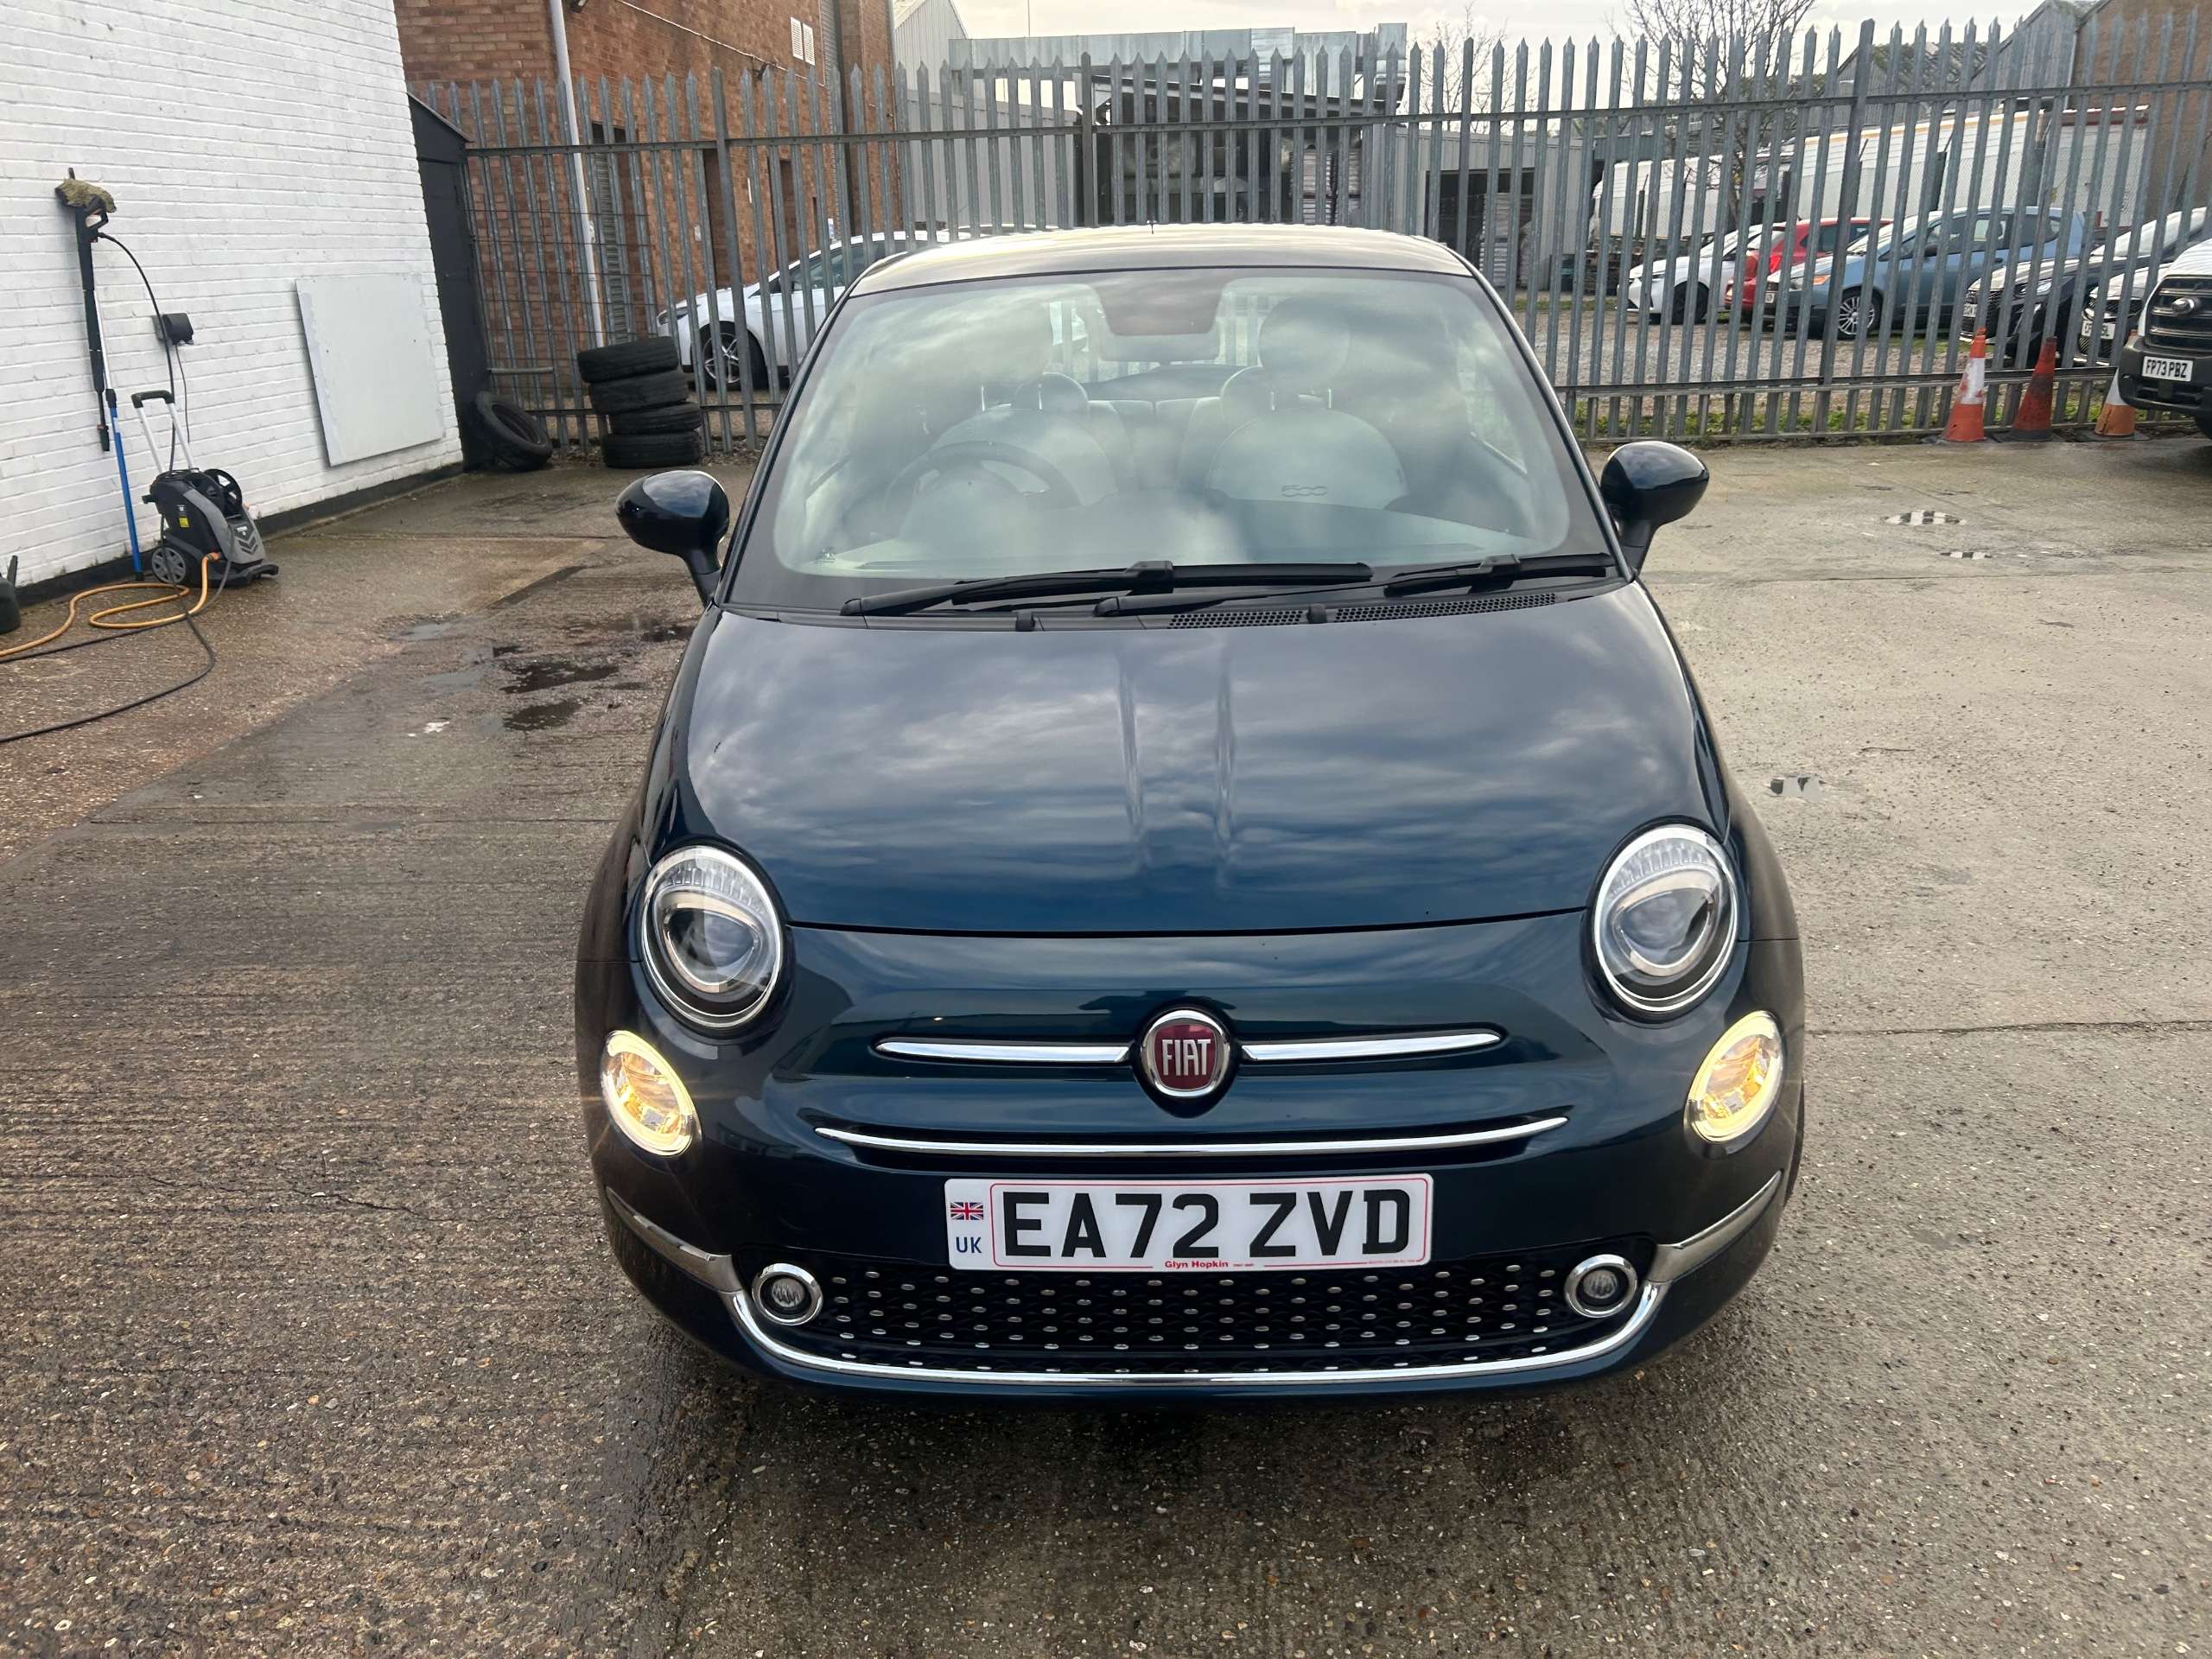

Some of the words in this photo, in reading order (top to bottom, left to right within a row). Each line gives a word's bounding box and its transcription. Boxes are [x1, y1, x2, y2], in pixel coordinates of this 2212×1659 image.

[2145, 359, 2167, 376] FP73
[2168, 361, 2188, 378] PBZ
[1161, 1039, 1211, 1076] FIAT
[1002, 1191, 1219, 1259] EA72
[1249, 1188, 1410, 1258] ZVD
[956, 1236, 982, 1254] UK
[1164, 1260, 1189, 1269] Glyn
[1192, 1260, 1229, 1269] Hopkin
